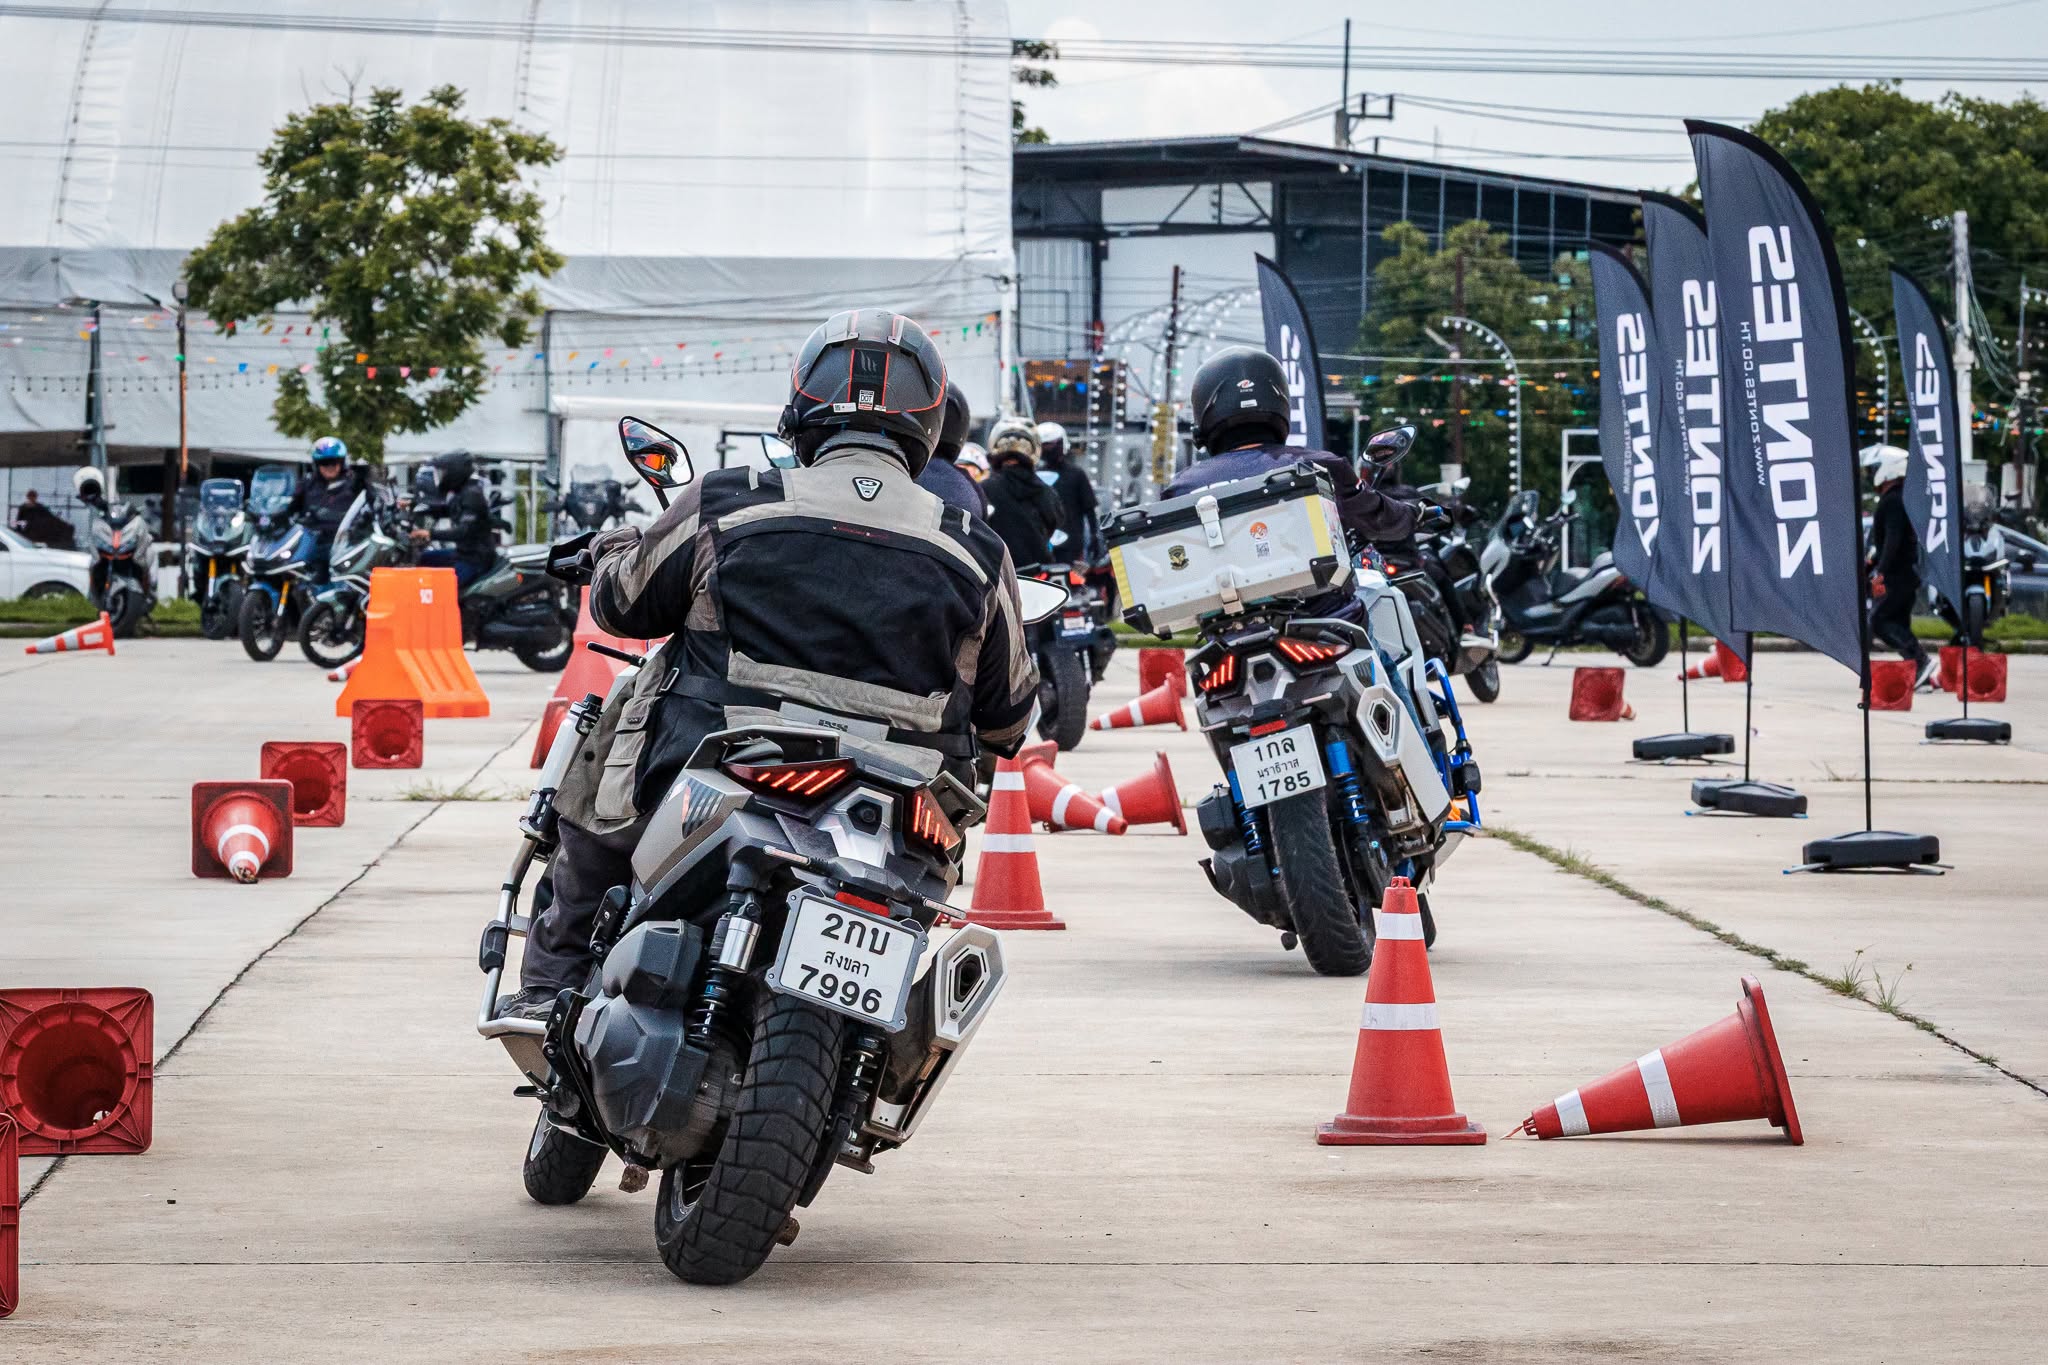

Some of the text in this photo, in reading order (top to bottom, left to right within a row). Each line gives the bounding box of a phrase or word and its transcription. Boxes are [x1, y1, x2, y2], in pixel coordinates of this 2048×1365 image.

[1254, 737, 1296, 762] 1กล
[1258, 759, 1299, 778] นราธิวาส
[1258, 770, 1311, 800] 1785
[820, 913, 890, 955] 2กบ
[824, 951, 869, 977] สงขลา
[798, 964, 882, 1013] 7996
